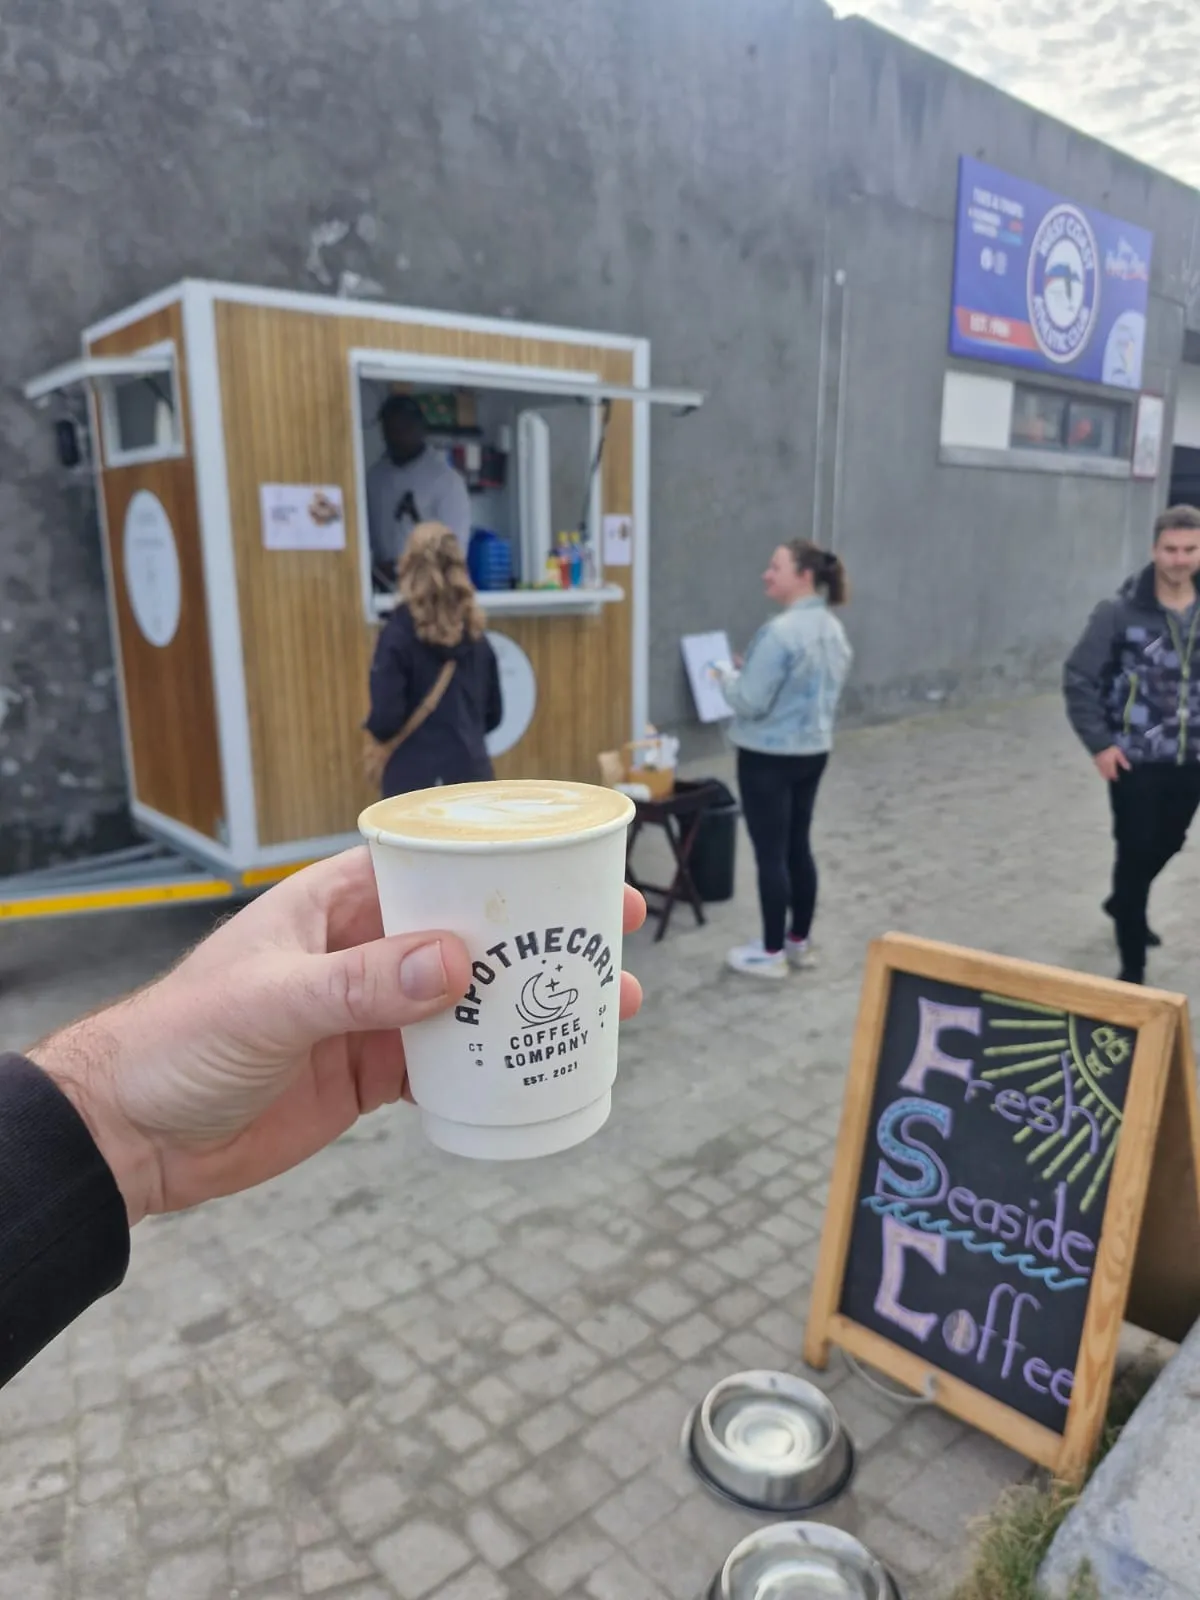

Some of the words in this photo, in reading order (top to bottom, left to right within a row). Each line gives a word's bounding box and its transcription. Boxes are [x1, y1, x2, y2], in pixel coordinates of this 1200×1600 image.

[454, 927, 614, 1026] APOTHECARY
[468, 1042, 484, 1052] CT
[503, 1030, 590, 1070] COMPANY
[509, 1017, 582, 1051] COFFEE
[523, 1073, 549, 1087] EST.
[552, 1061, 579, 1079] 2021
[898, 995, 1100, 1156] Fresh
[874, 1096, 1094, 1274] Seaside
[873, 1212, 1075, 1406] Coffee
